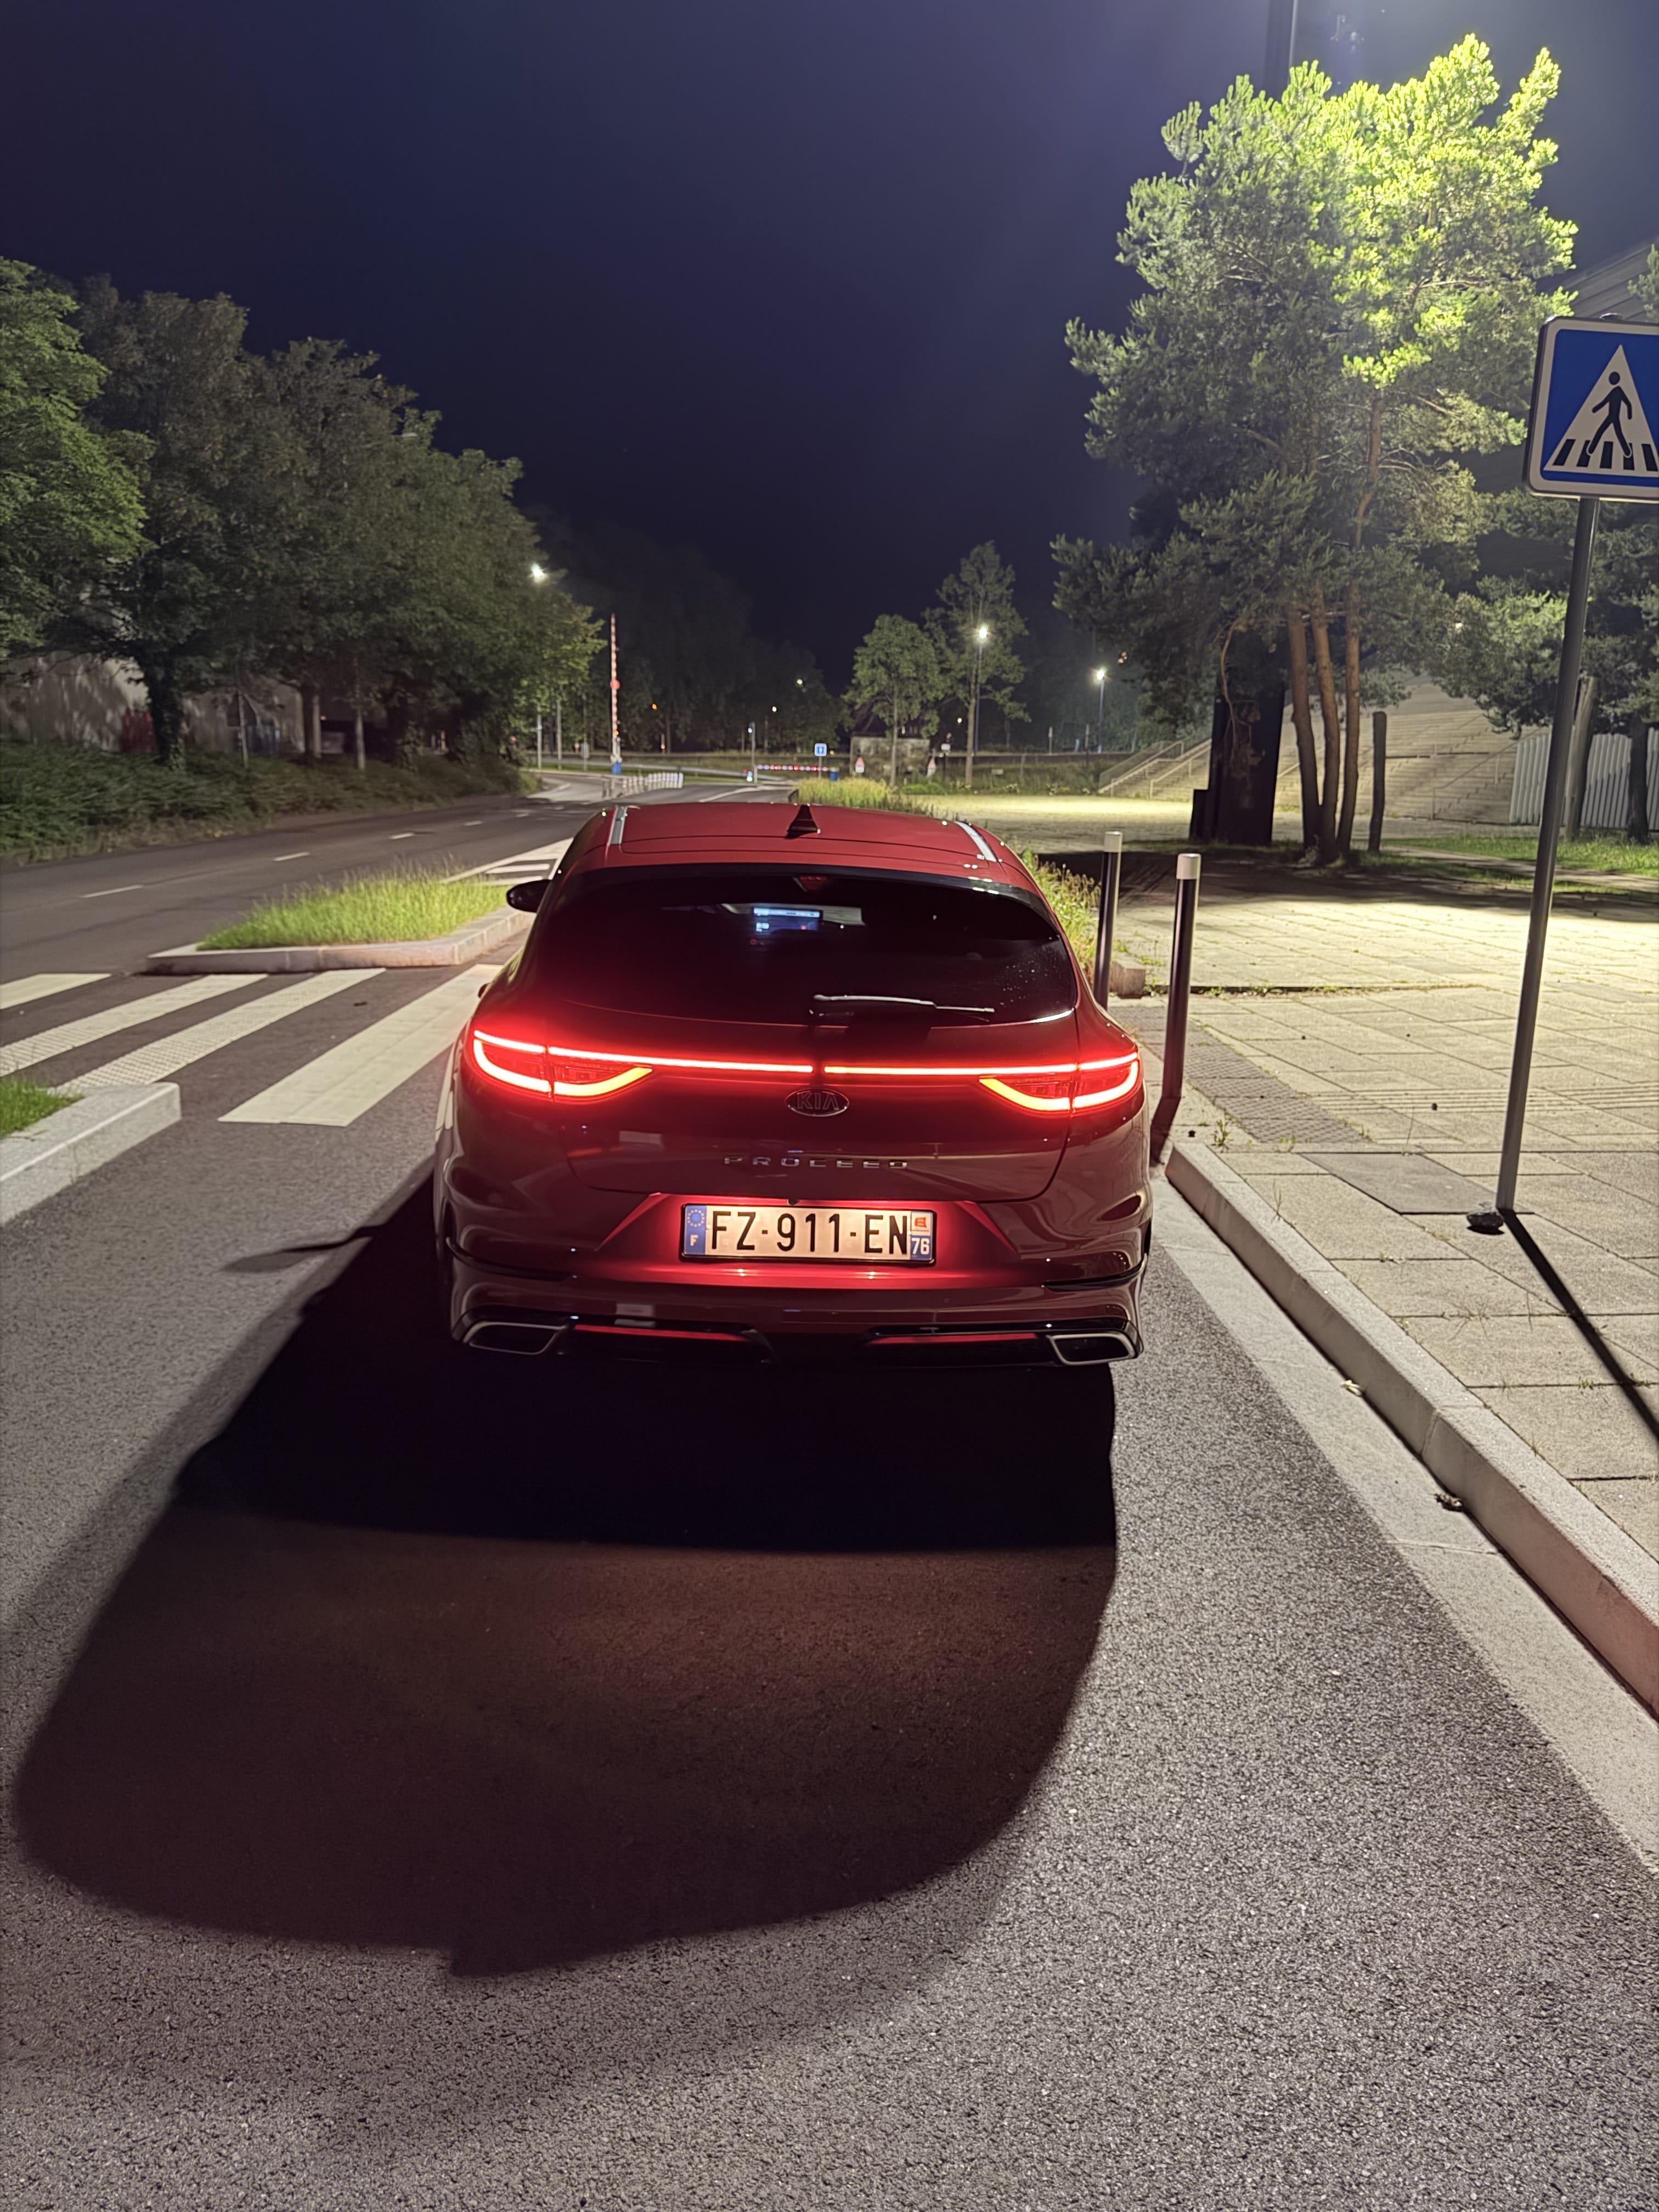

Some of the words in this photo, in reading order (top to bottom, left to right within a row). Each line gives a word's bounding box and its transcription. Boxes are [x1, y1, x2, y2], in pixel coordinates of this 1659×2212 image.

[797, 1092, 839, 1110] KIA
[724, 1156, 907, 1169] PROCEED
[690, 1234, 698, 1246] F
[712, 1210, 907, 1255] FZ-911-EN
[911, 1237, 930, 1255] 76
